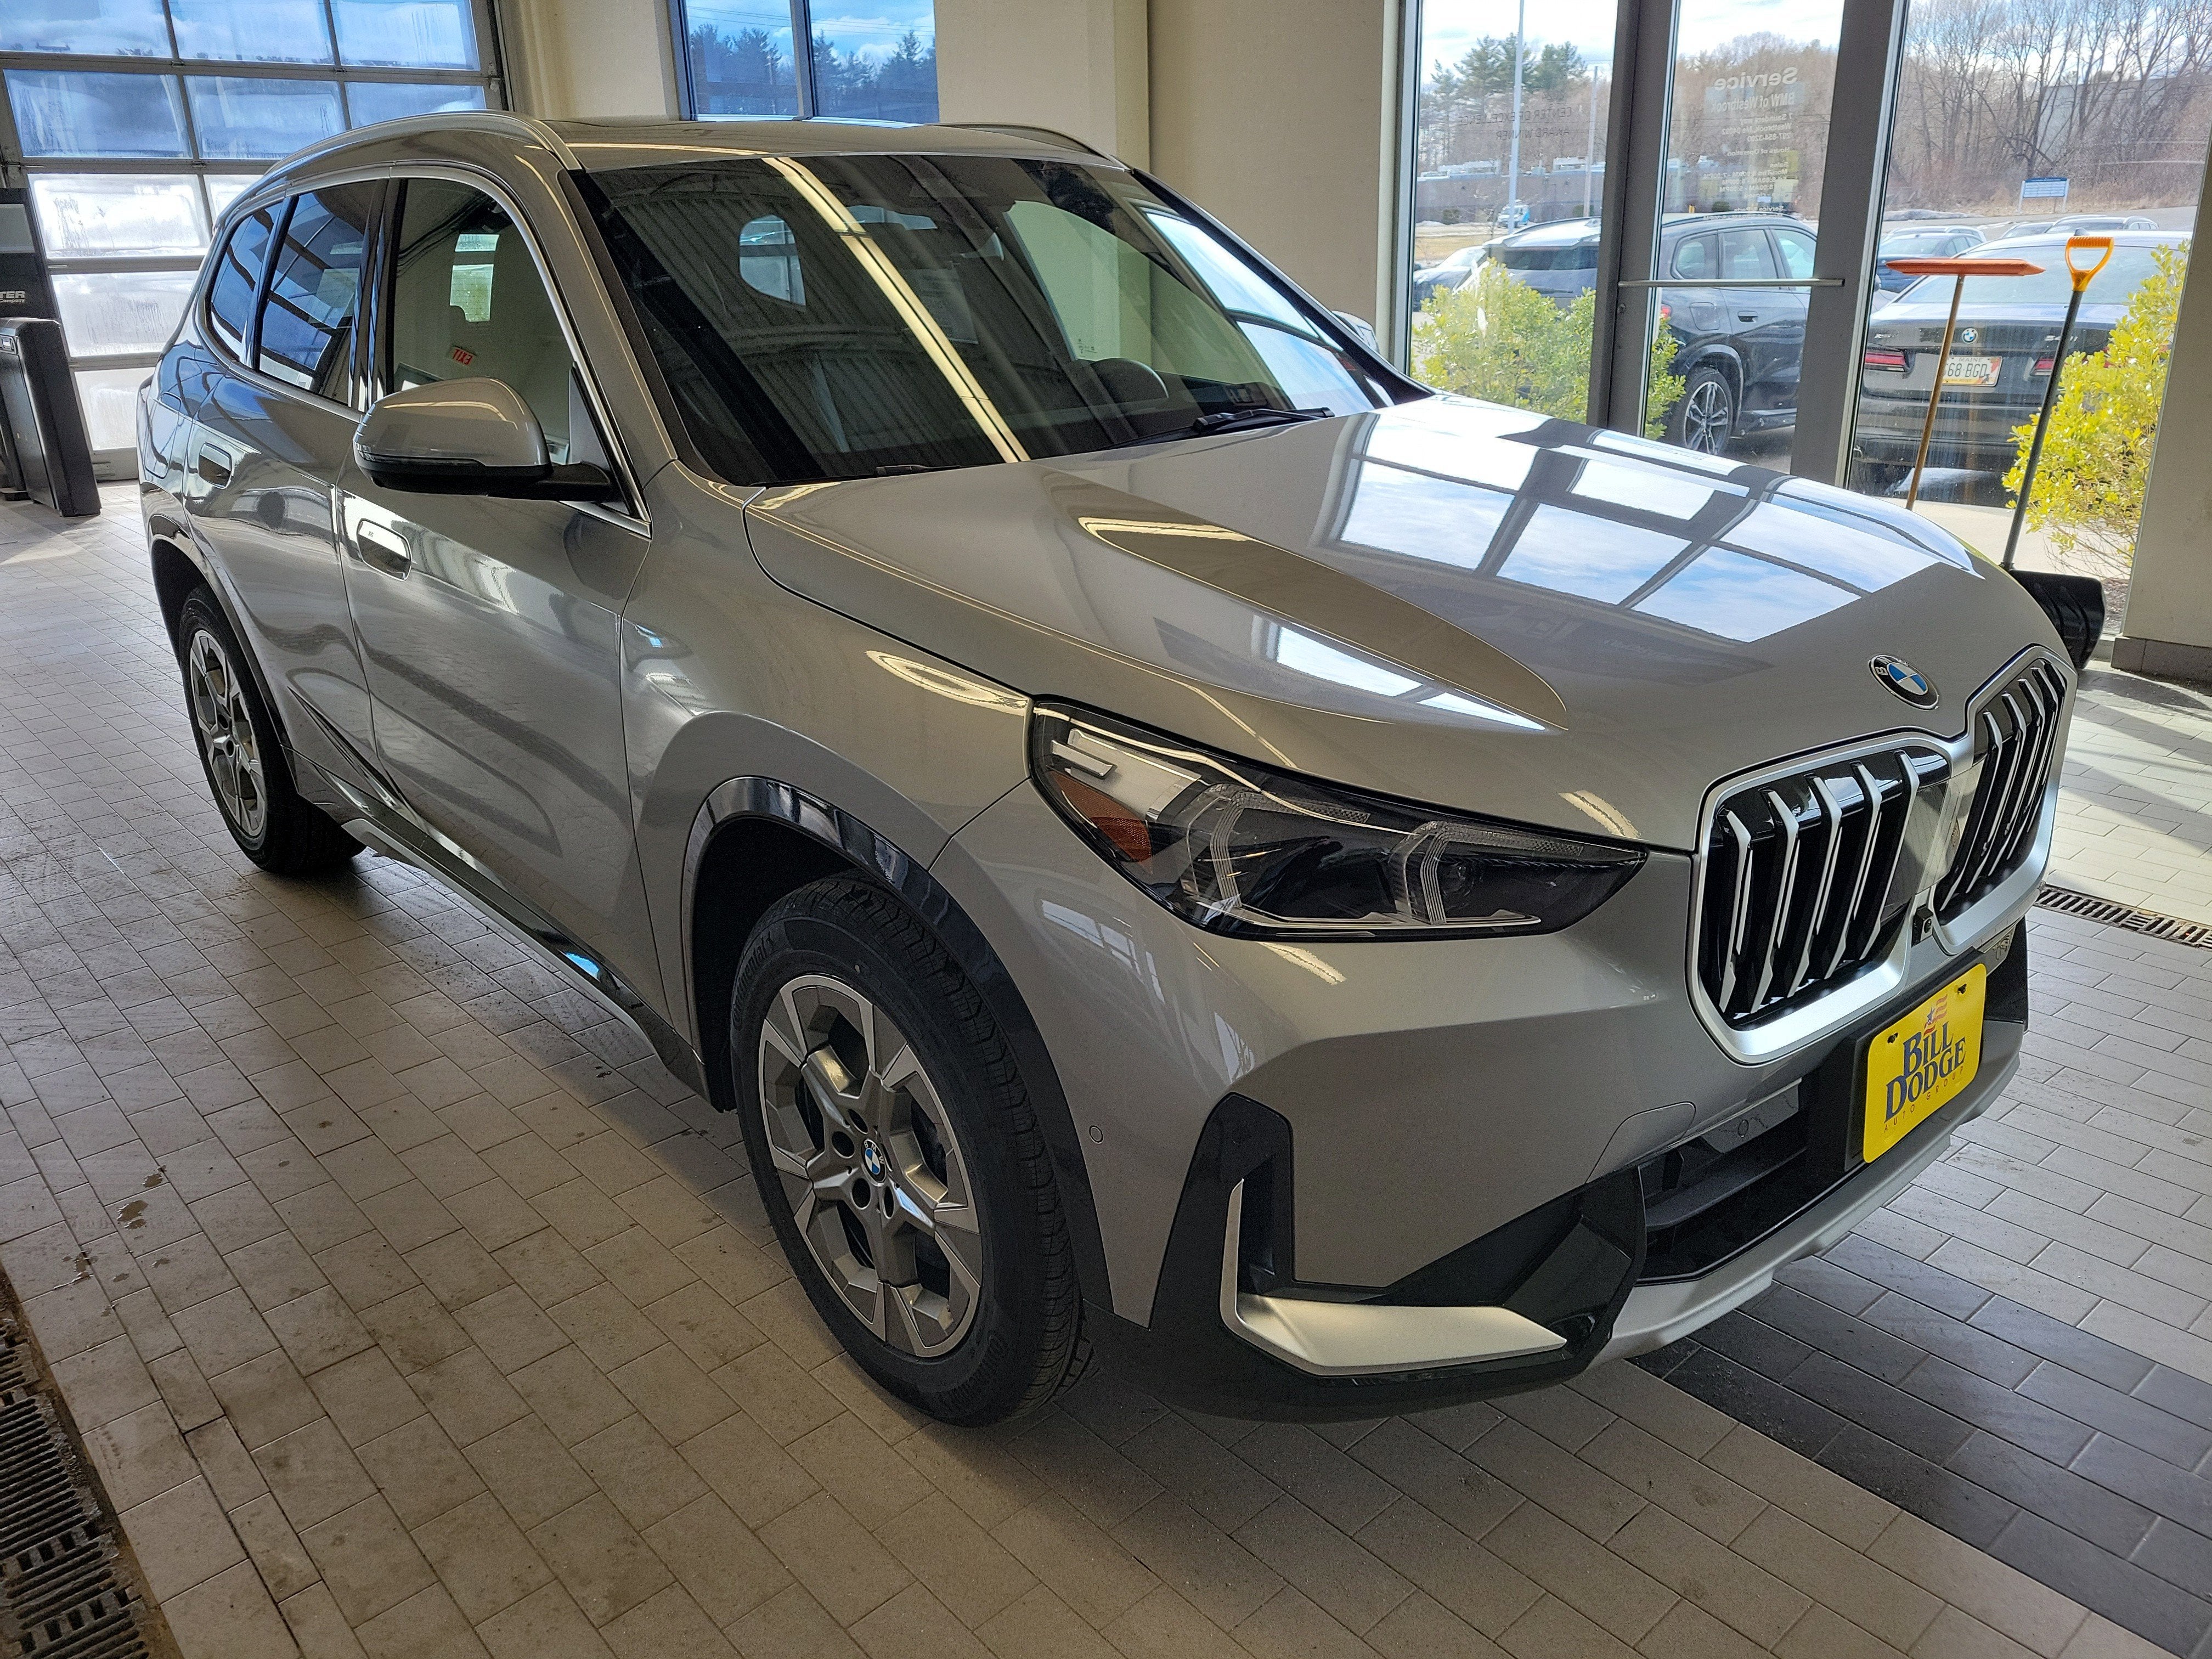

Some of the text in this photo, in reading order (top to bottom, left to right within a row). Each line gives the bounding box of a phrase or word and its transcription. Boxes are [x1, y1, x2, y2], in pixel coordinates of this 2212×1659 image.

[1883, 1036, 1966, 1124] DODGE
[1903, 1021, 1954, 1077] BILL
[1883, 1065, 1964, 1133] AUTO GROUP
[864, 1141, 885, 1164] BMW
